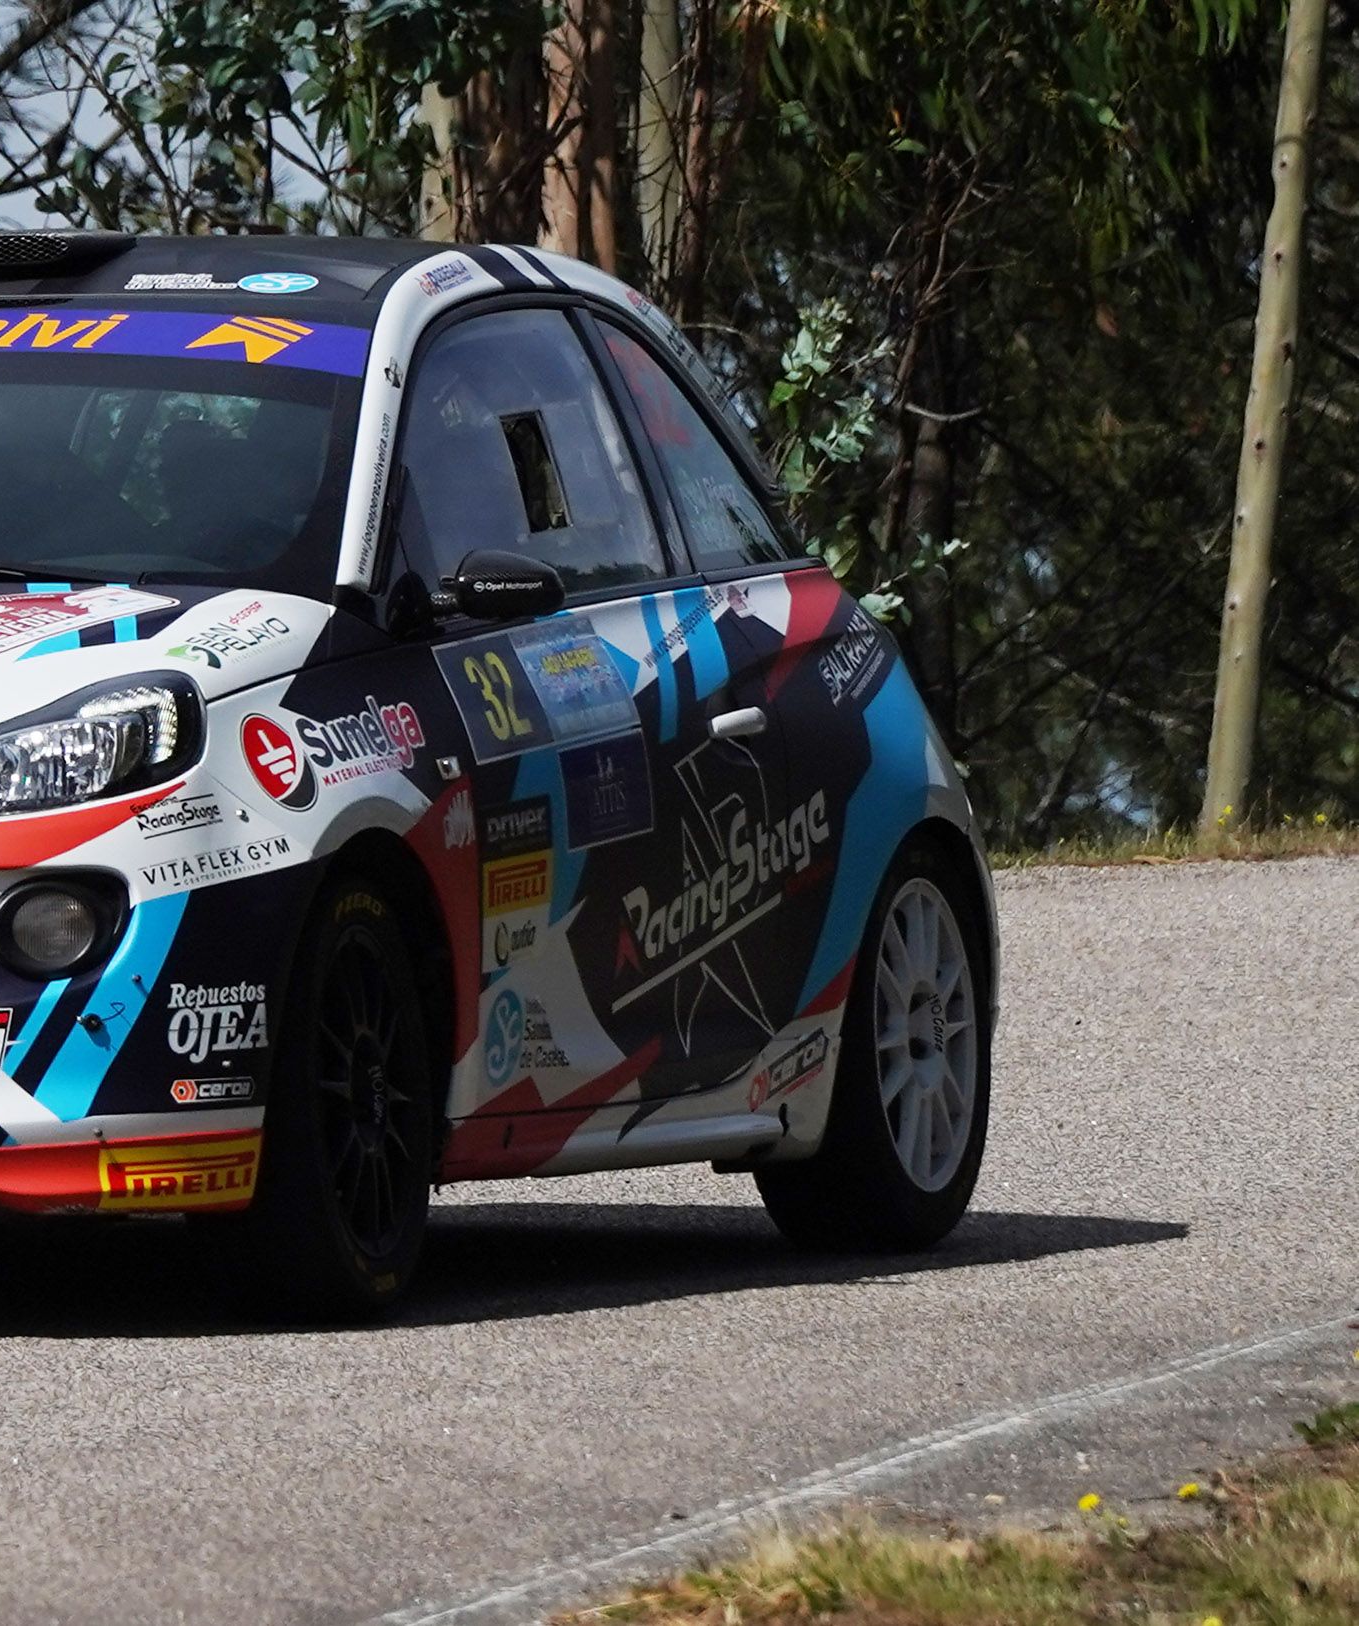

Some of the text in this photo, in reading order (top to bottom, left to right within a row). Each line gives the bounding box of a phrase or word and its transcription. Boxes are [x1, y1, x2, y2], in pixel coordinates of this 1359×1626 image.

[485, 581, 504, 591] Opel
[186, 622, 238, 646] SAN
[210, 617, 290, 657] PELAYO
[463, 651, 533, 741] 32
[295, 695, 426, 769] Sumelga
[323, 765, 368, 788] MATERIAL
[137, 802, 221, 831] RacingStage
[142, 838, 291, 885] VITA FLEX GYM
[488, 859, 547, 908] PIRELLI
[167, 980, 266, 1012] Repuestos
[168, 1003, 269, 1063] OJEA
[106, 1149, 256, 1199] PIRELLI
